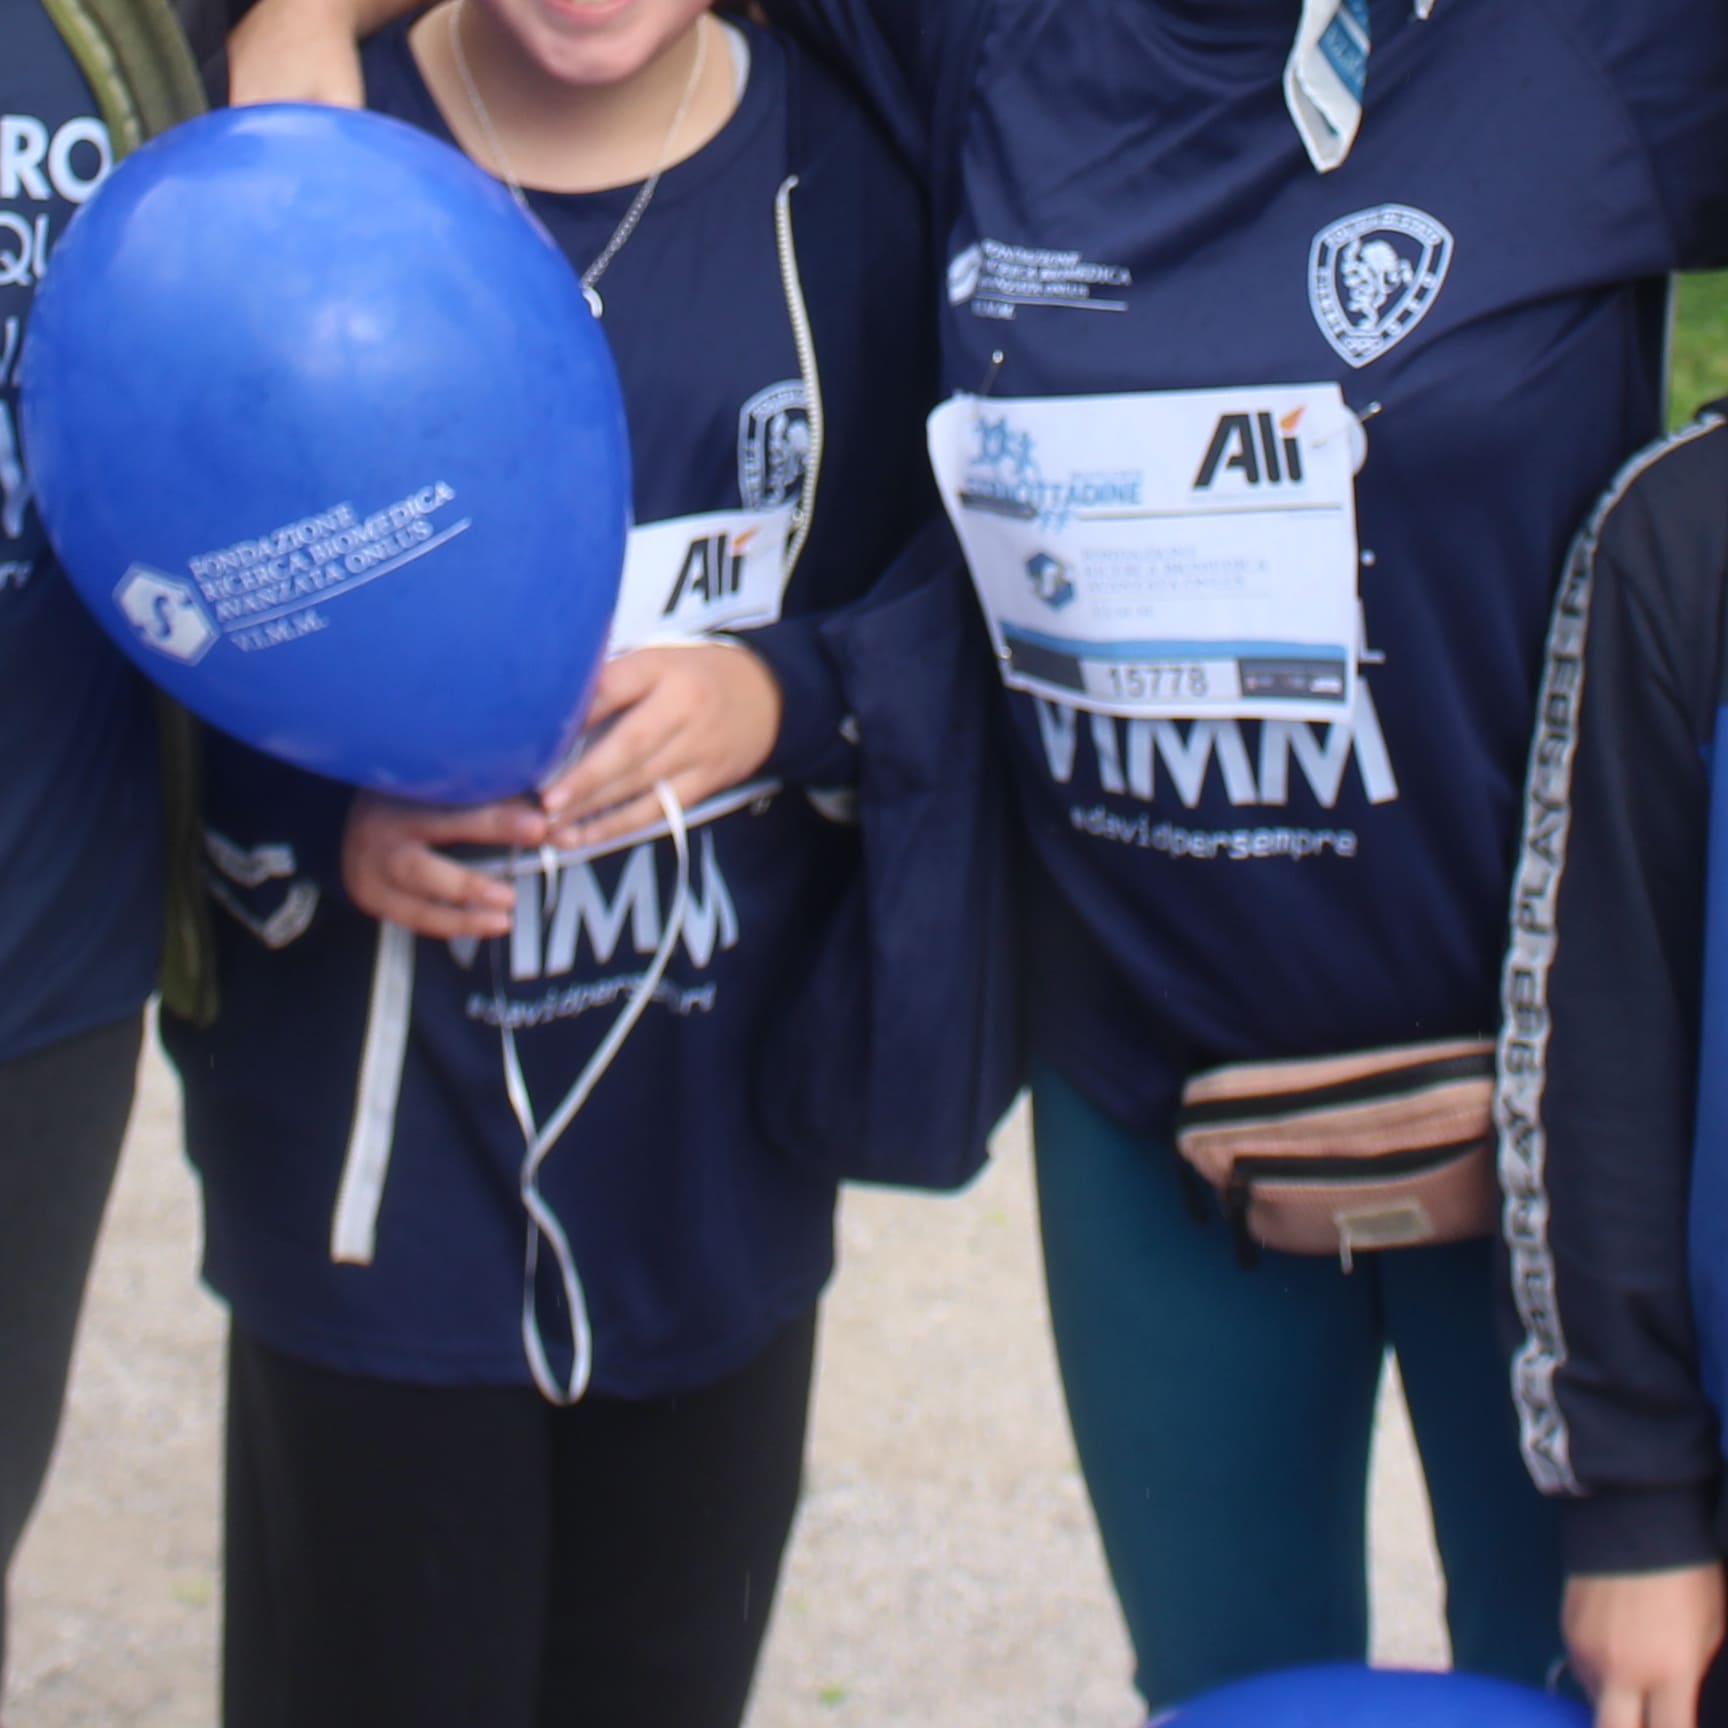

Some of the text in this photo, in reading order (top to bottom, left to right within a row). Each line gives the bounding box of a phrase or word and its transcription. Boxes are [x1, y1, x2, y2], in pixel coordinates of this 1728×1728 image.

[308, 480, 456, 565] BIOMEDICA
[344, 518, 434, 573] ONLUS
[1108, 665, 1209, 698] 15778
